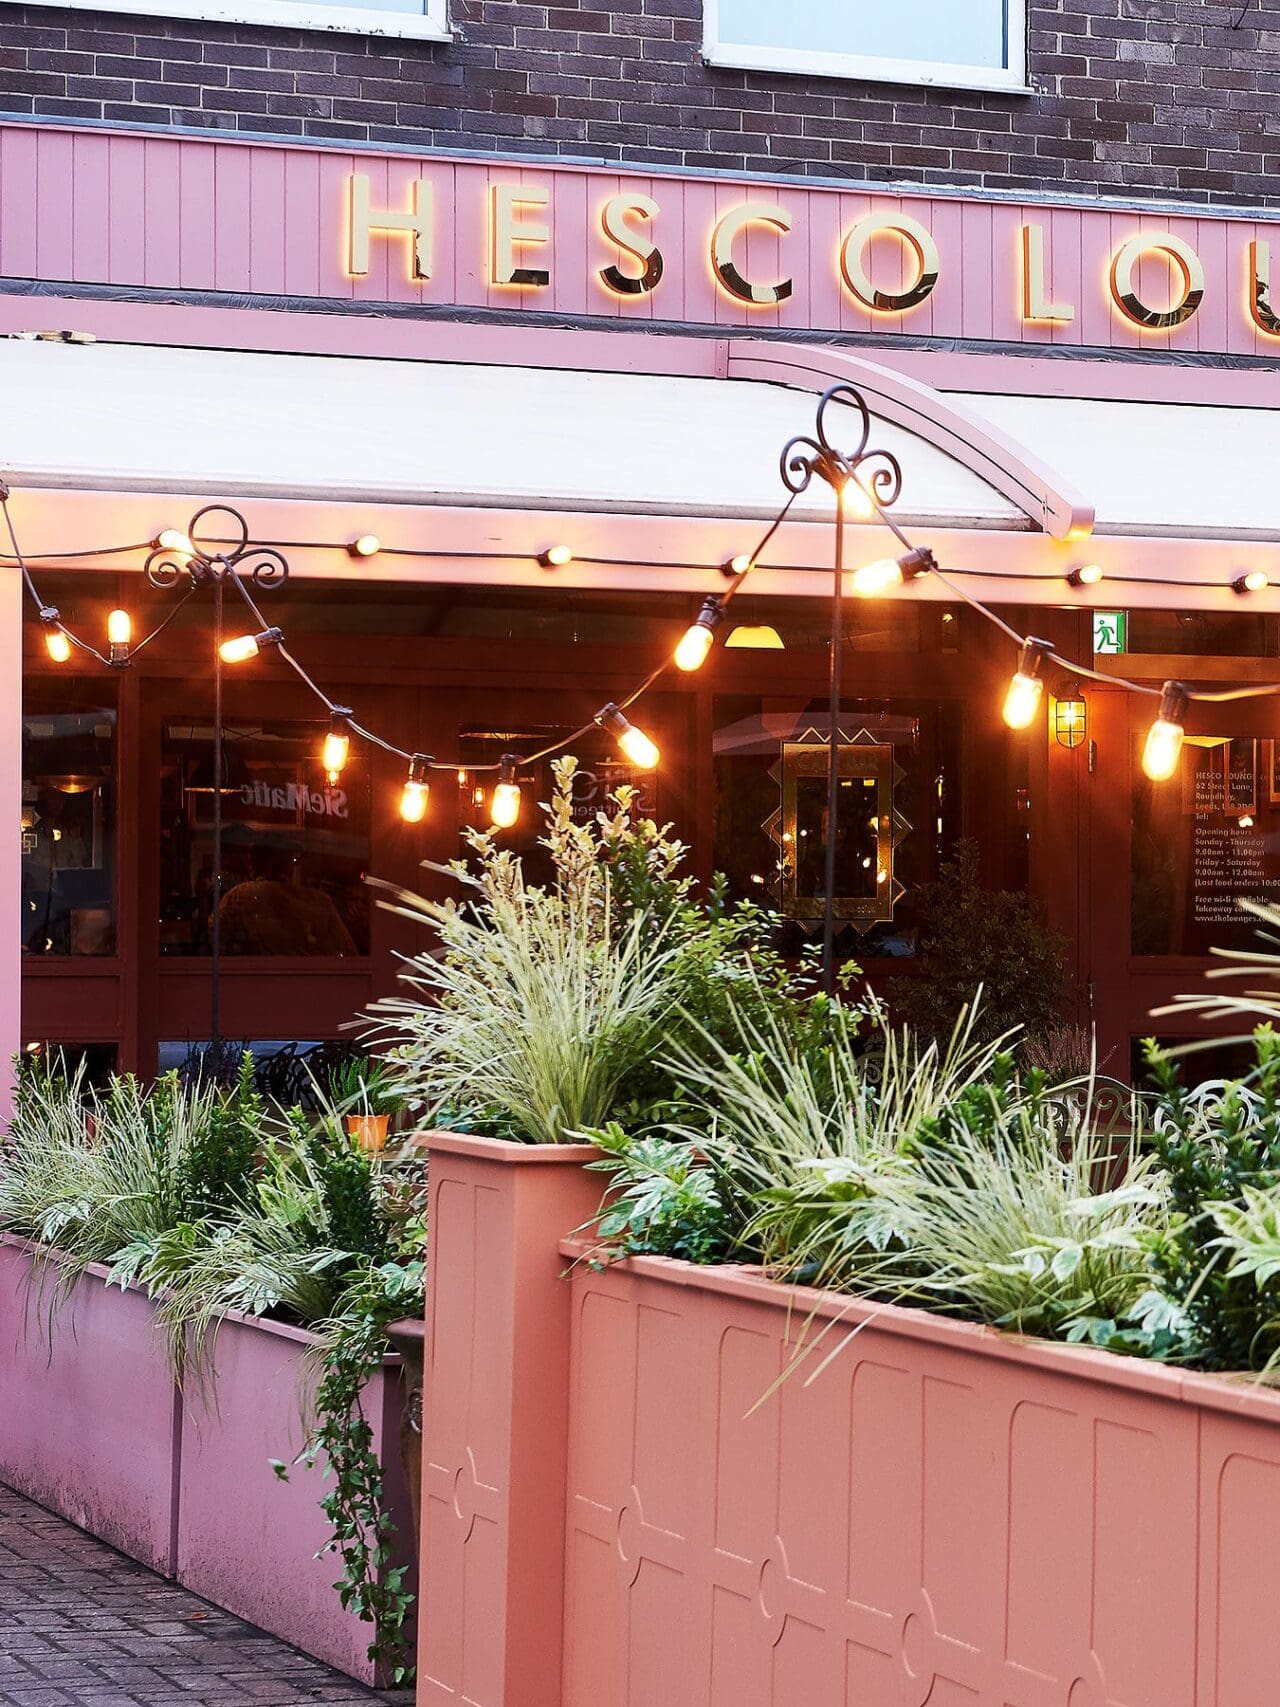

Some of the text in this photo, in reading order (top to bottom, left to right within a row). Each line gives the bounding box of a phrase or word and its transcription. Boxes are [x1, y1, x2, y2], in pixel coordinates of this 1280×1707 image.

[349, 174, 939, 312] HESCO
[1195, 772, 1222, 780] HESCO
[1224, 772, 1256, 780] OUNG
[1195, 782, 1205, 790] 62
[1231, 783, 1253, 791] Lane,
[1195, 792, 1236, 801] Roundhy,
[1195, 802, 1220, 810] Leeds,
[1195, 812, 1209, 820] Tel:
[1195, 827, 1229, 836] Opening
[1195, 838, 1224, 847] Sunday
[1230, 838, 1265, 847] Thursday
[1195, 848, 1224, 856] 9.00am
[1232, 848, 1265, 857] 11.00pm
[1195, 858, 1219, 867] Friday
[1226, 858, 1261, 867] Saturday
[1194, 879, 1213, 887] (Last
[1194, 895, 1212, 903] Free
[1213, 895, 1231, 903] wi-fi
[1195, 905, 1233, 913] Takeaway
[1194, 914, 1277, 923] www.thelounges.co
